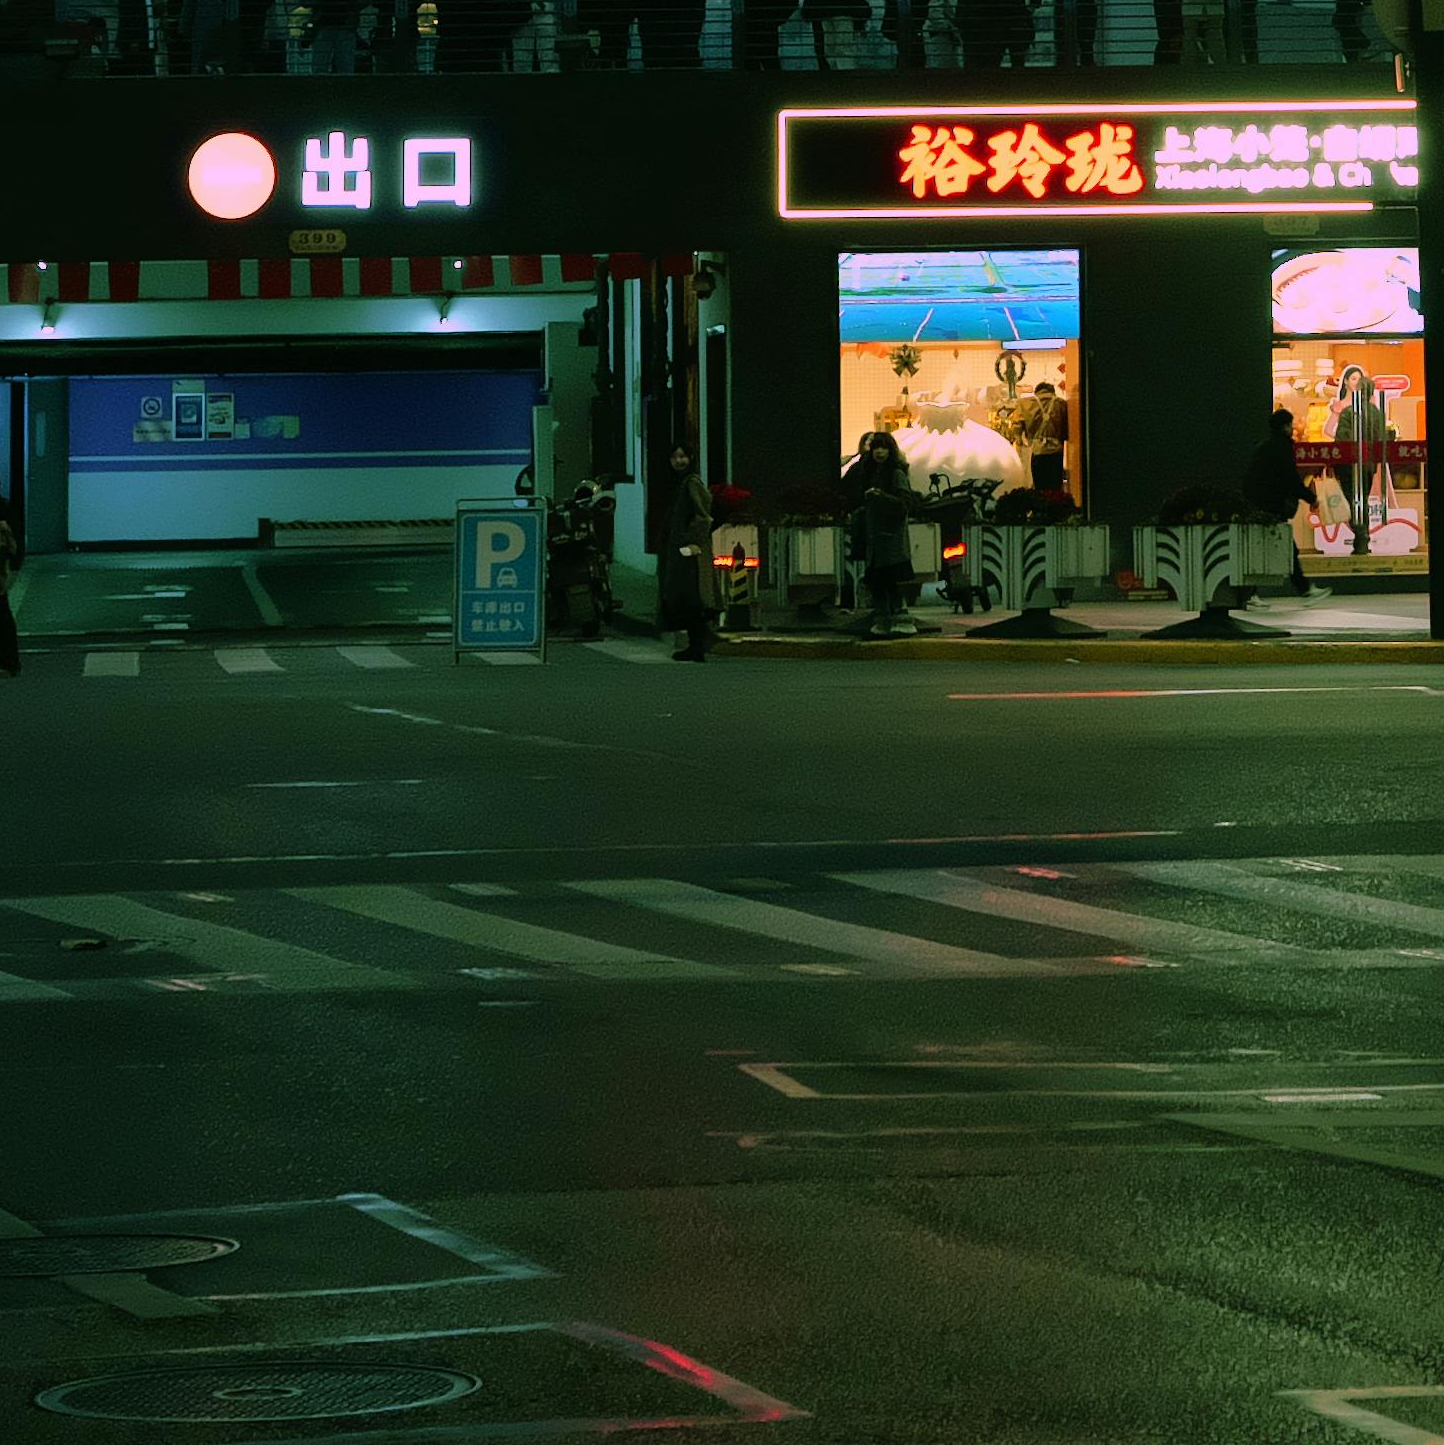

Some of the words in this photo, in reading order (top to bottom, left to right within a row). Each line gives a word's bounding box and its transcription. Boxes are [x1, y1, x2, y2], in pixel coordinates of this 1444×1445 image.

[299, 130, 473, 210] 出口
[898, 121, 1145, 199] 裕玲珑
[299, 232, 336, 245] 399
[475, 520, 526, 590] P
